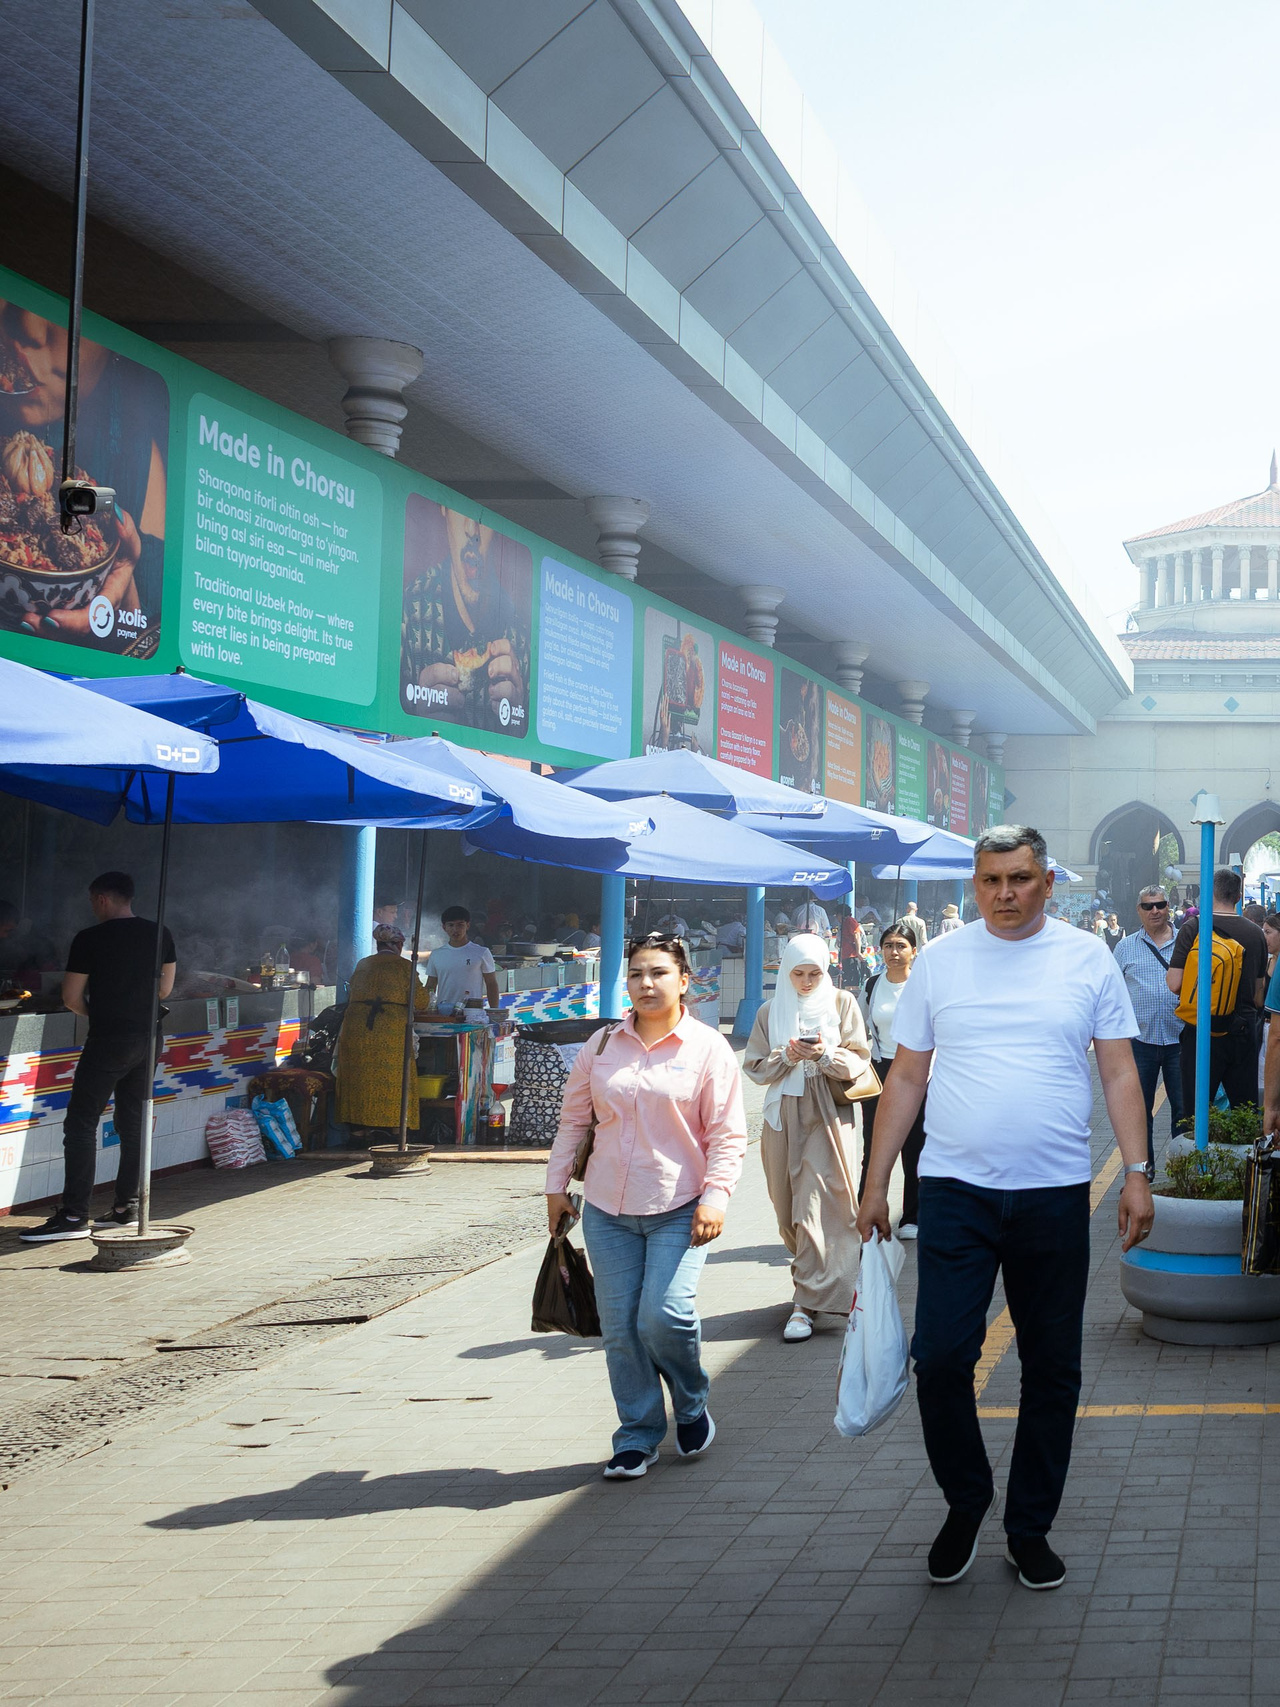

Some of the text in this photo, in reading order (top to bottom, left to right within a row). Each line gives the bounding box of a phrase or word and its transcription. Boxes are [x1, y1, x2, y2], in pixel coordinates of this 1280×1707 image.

[199, 414, 354, 509] Made in Chorsu
[197, 489, 213, 510] bir
[216, 496, 252, 524] donasi
[254, 514, 313, 548] ziravorlarga
[198, 467, 348, 539] Sharqona iforli oltin osh har
[195, 534, 305, 584] bilan tayyorlaganida.
[197, 512, 339, 575] Uning asl siri esa uni mehr
[118, 608, 147, 629] xolis
[194, 571, 354, 632] Traditional Uzbek Palov where
[545, 570, 619, 623] Made in Chorsu
[117, 629, 137, 639] paynet
[192, 620, 335, 666] secret lies in being prepared
[193, 597, 352, 651] every bite brings delight. Its true
[191, 641, 242, 665] with love.
[721, 651, 766, 684] Made in Chorsu
[414, 685, 448, 707] paynet
[511, 705, 525, 718] xolis
